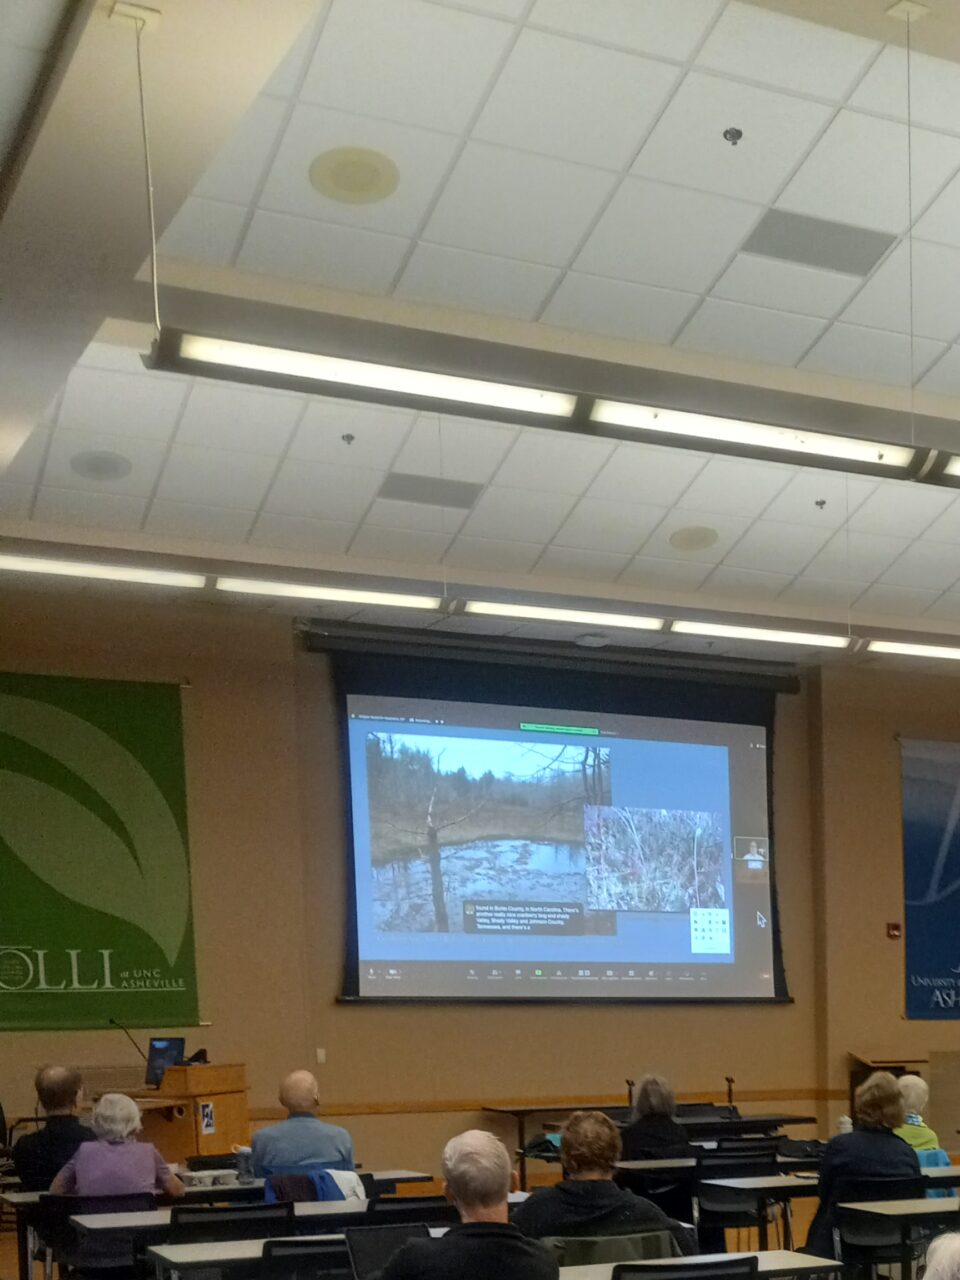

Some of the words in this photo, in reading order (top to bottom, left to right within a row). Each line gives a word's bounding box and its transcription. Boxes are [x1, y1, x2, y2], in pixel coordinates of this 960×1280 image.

[0, 949, 115, 990] OLLI
[133, 968, 161, 978] UNC
[121, 978, 185, 988] ASHEVILLE
